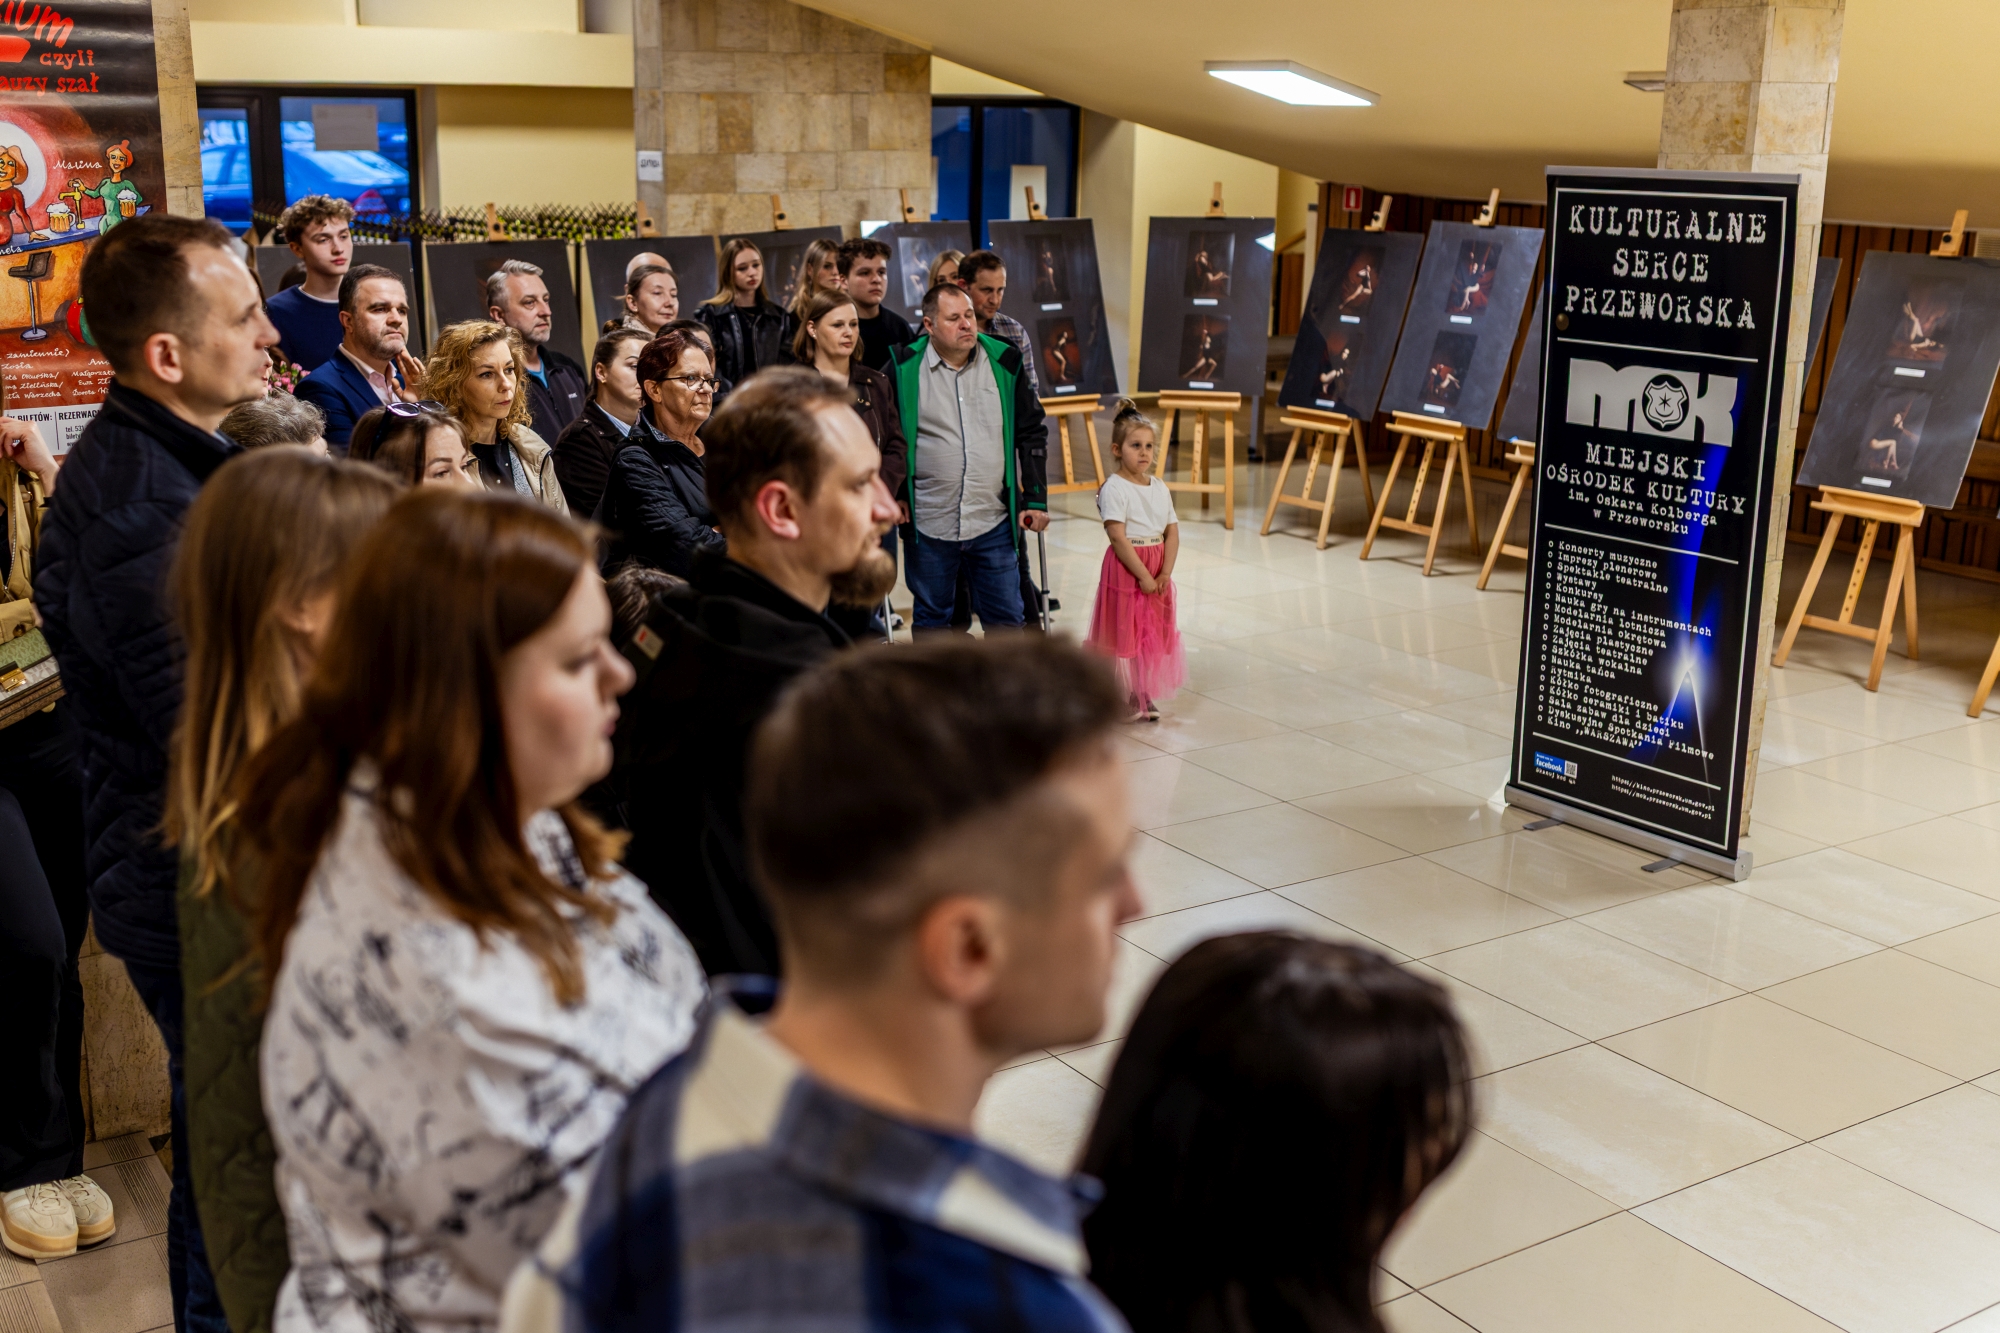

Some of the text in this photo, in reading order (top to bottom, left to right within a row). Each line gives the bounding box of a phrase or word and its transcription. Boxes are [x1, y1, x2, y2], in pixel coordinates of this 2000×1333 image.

[40, 49, 95, 70] czyli
[0, 72, 100, 97] auzy szał
[53, 160, 103, 170] Malina
[1569, 205, 1767, 243] KULTURALNE
[1613, 248, 1709, 283] SERCE
[1564, 285, 1756, 329] PRZEWORSKA
[58, 409, 100, 421] REZERWAC
[1586, 442, 1706, 482] MIEJSKI
[1547, 463, 1746, 515] OŚRODEK KULTURY
[1568, 488, 1717, 527] im. Oskara Kolberga
[1593, 509, 1689, 535] w Przeworsku
[1558, 541, 1658, 569] Koncerty muzyczne
[1558, 551, 1657, 580] Imprezy plenerowe
[1556, 572, 1597, 590] Wystawy
[1556, 583, 1604, 602] Konkursy
[1557, 562, 1669, 593] Spektakle teatralne
[1553, 613, 1667, 648] Modelarnia okrętowa
[1554, 603, 1666, 637] Modelarnia lotnicza
[1555, 593, 1712, 637] Nauka gry na instrumentach
[1552, 635, 1648, 666] Zajęcia teatralne
[1553, 624, 1654, 657] Zajęcia plastyczne
[1550, 666, 1592, 683] Rytmika
[1551, 645, 1642, 675] Szkółka wokalna
[1551, 655, 1616, 679] Nauka tańca
[1549, 685, 1684, 730] Kółko ceramiki i batiku
[1550, 675, 1659, 712] Kółko fotograficzne
[1547, 716, 1571, 731] Kino
[1548, 695, 1671, 737] Sala zabaw dla dzieci
[1548, 705, 1715, 760] Dyskusyjne Spotkania Filmowe
[1536, 758, 1563, 773] facebook
